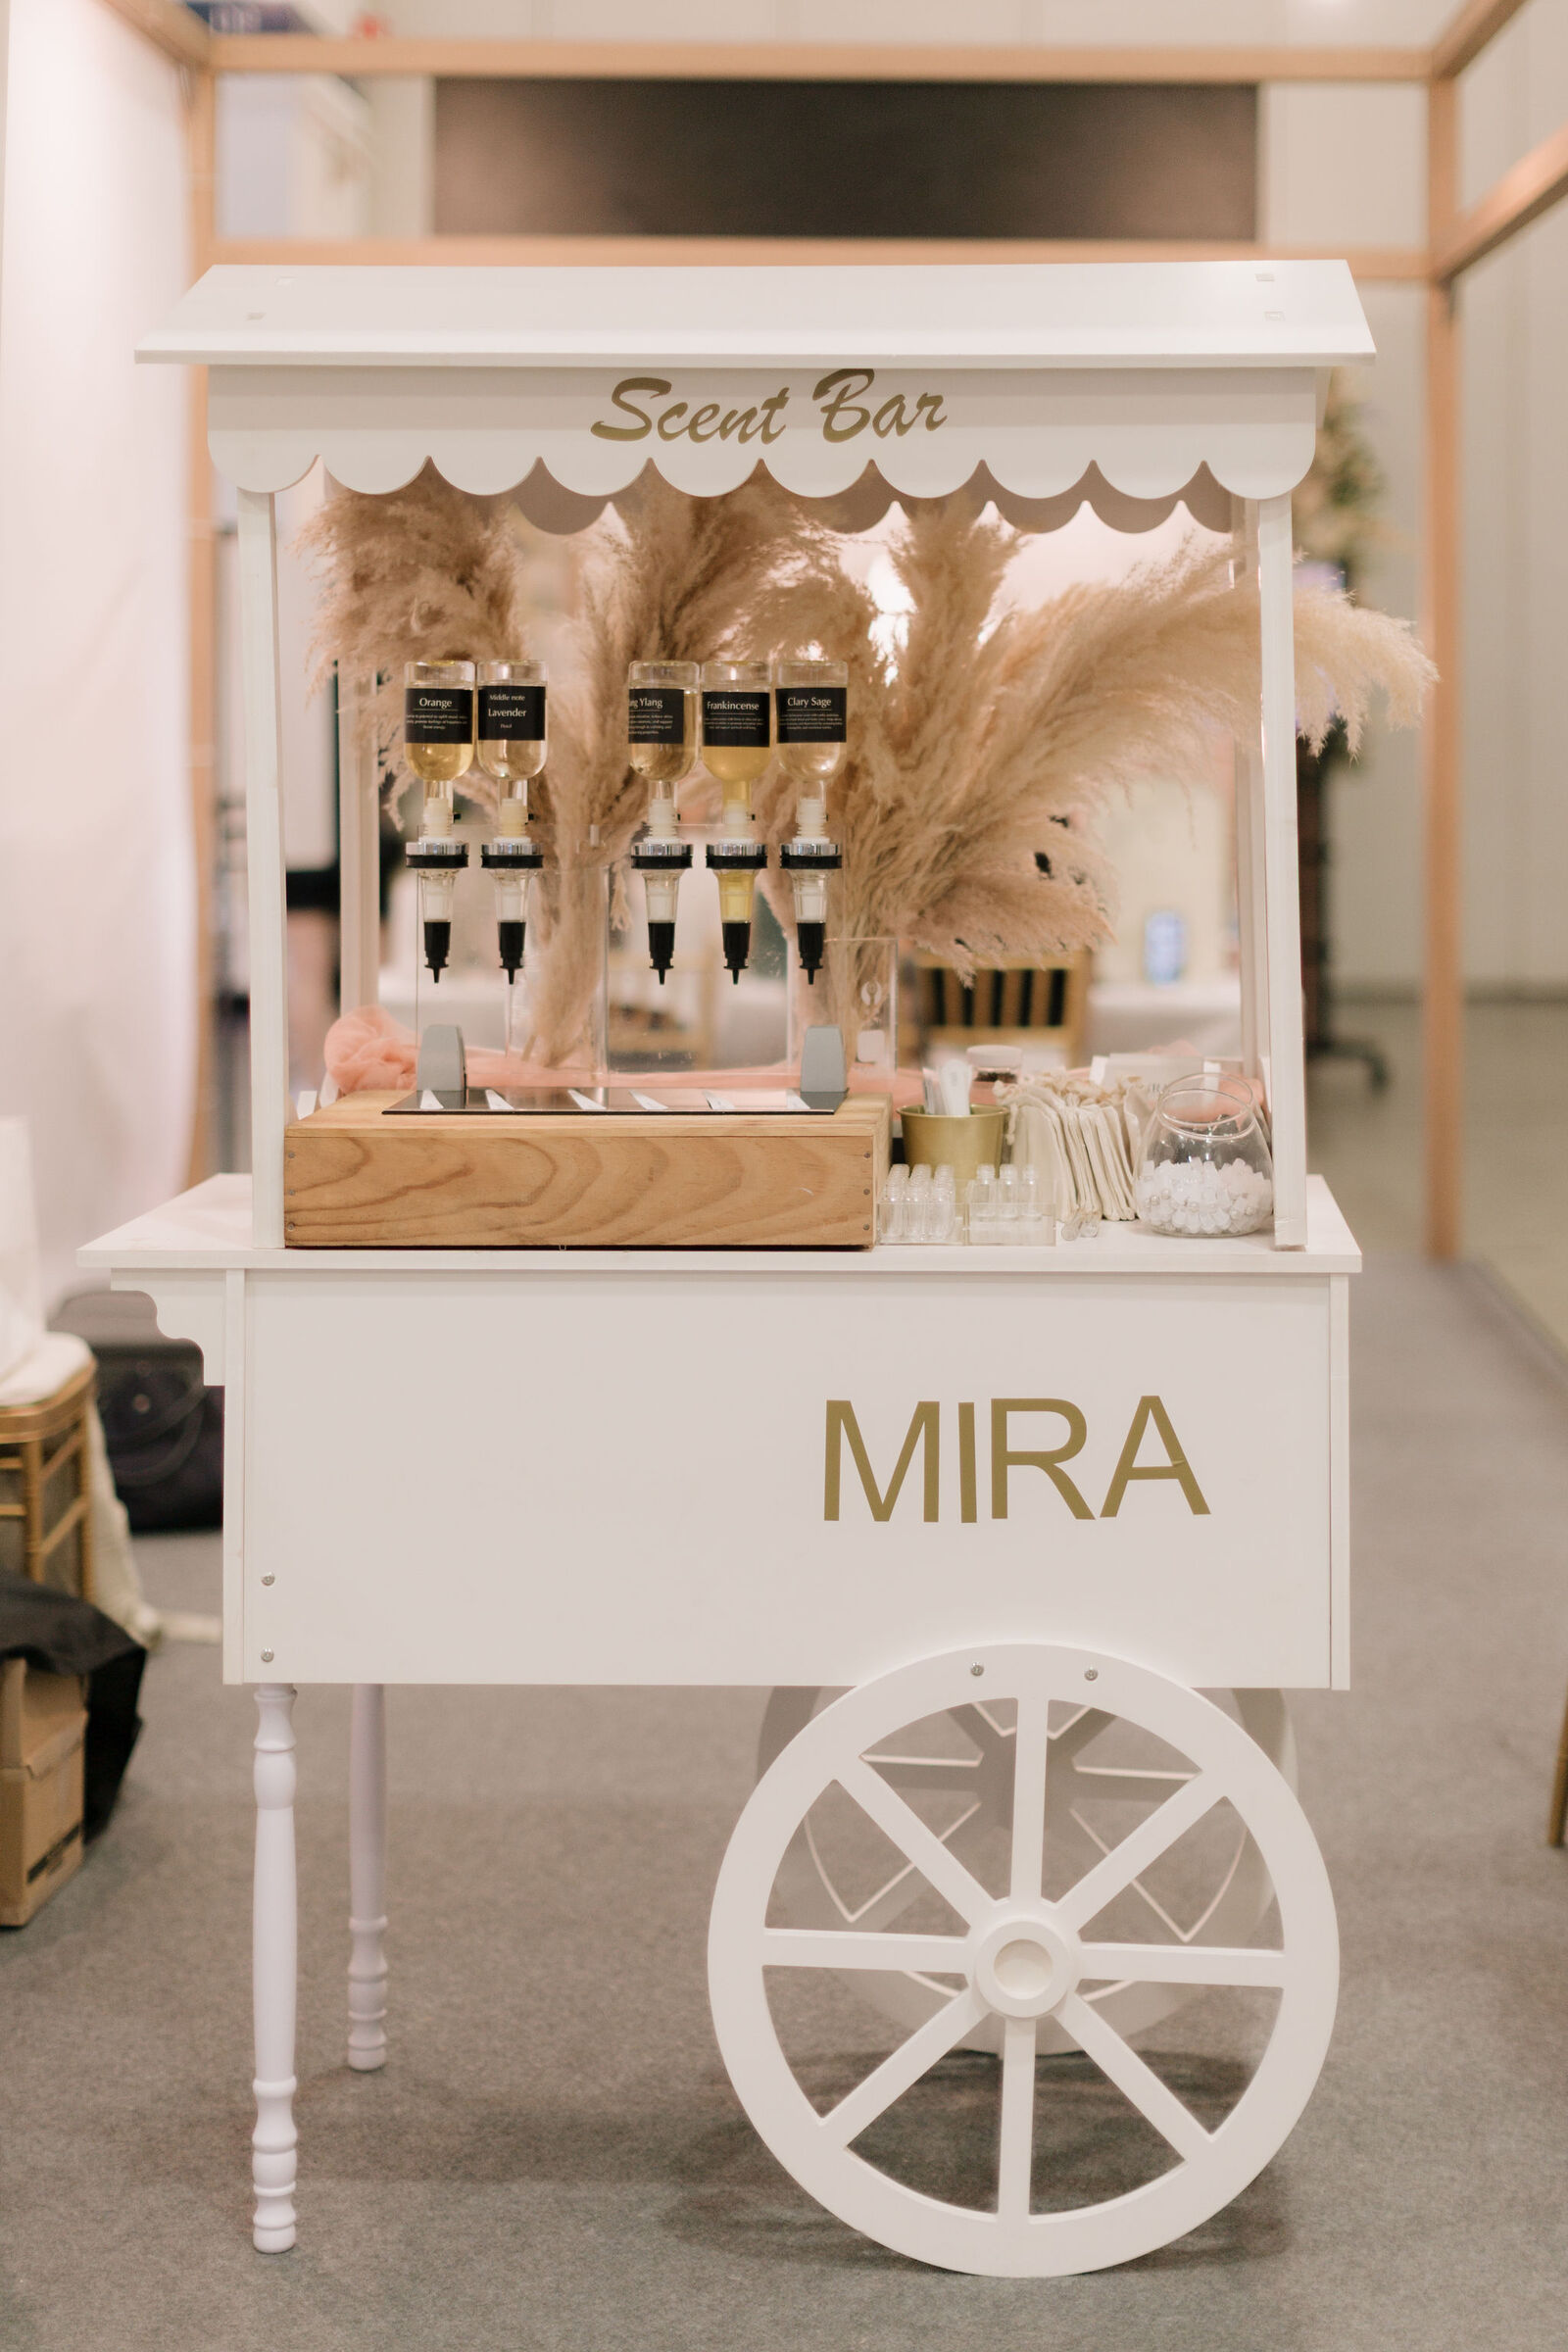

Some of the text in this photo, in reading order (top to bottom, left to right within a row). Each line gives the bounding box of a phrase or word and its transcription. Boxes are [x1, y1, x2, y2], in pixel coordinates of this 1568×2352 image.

[590, 368, 948, 445] Scent Bar
[418, 697, 453, 710] Orange
[639, 697, 663, 710] Ylang
[707, 700, 760, 710] Frankincense
[787, 697, 832, 709] Clary Sage
[488, 708, 527, 717] Lavender
[824, 1395, 1211, 1523] MIRA
